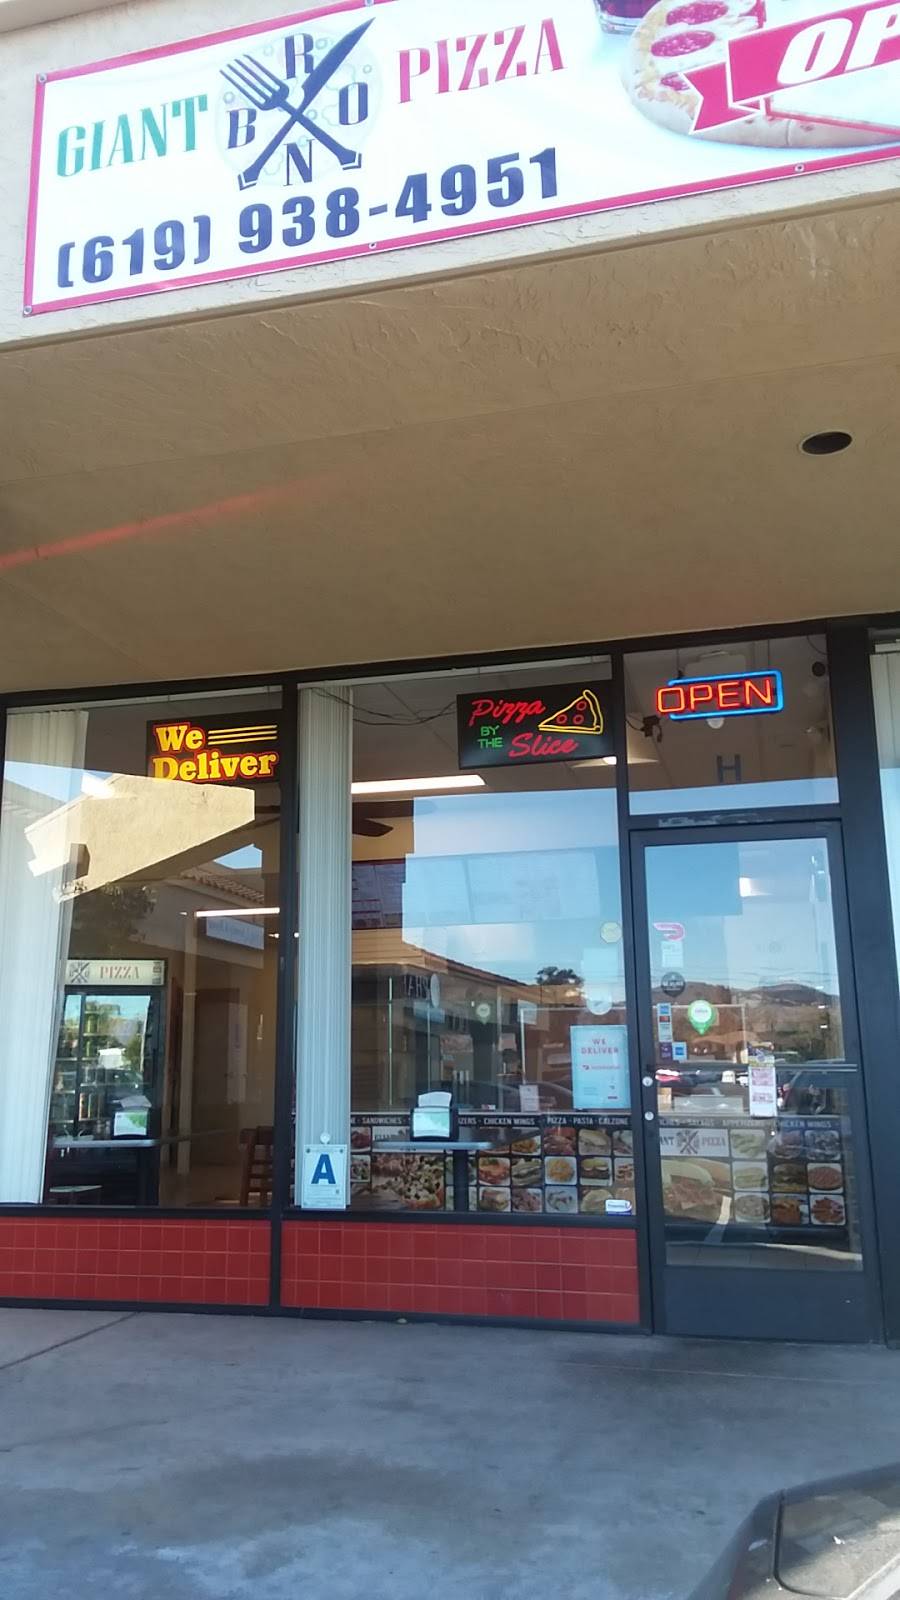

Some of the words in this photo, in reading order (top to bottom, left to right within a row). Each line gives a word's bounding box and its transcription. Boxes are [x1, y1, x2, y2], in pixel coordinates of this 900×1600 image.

[56, 94, 208, 178] GIANT
[397, 17, 568, 104] PIZZA
[57, 215, 211, 288] (619)
[238, 147, 559, 253] 938-4951
[657, 677, 773, 713] OPEN
[468, 699, 546, 726] Pizza
[153, 722, 206, 752] We
[477, 737, 503, 749] THE
[480, 725, 499, 737] BY
[508, 732, 579, 758] Slice
[151, 749, 279, 783] Deliver
[100, 966, 140, 980] PIZZA
[581, 1047, 619, 1055] DELIVER
[361, 1117, 402, 1125] SANDWICHES
[483, 1117, 512, 1125] CHICKEN
[513, 1117, 536, 1126] WINGS
[546, 1117, 567, 1125] PIZZA
[573, 1117, 594, 1125] PASTA
[598, 1117, 629, 1126] CALZONE
[311, 1154, 336, 1184] A
